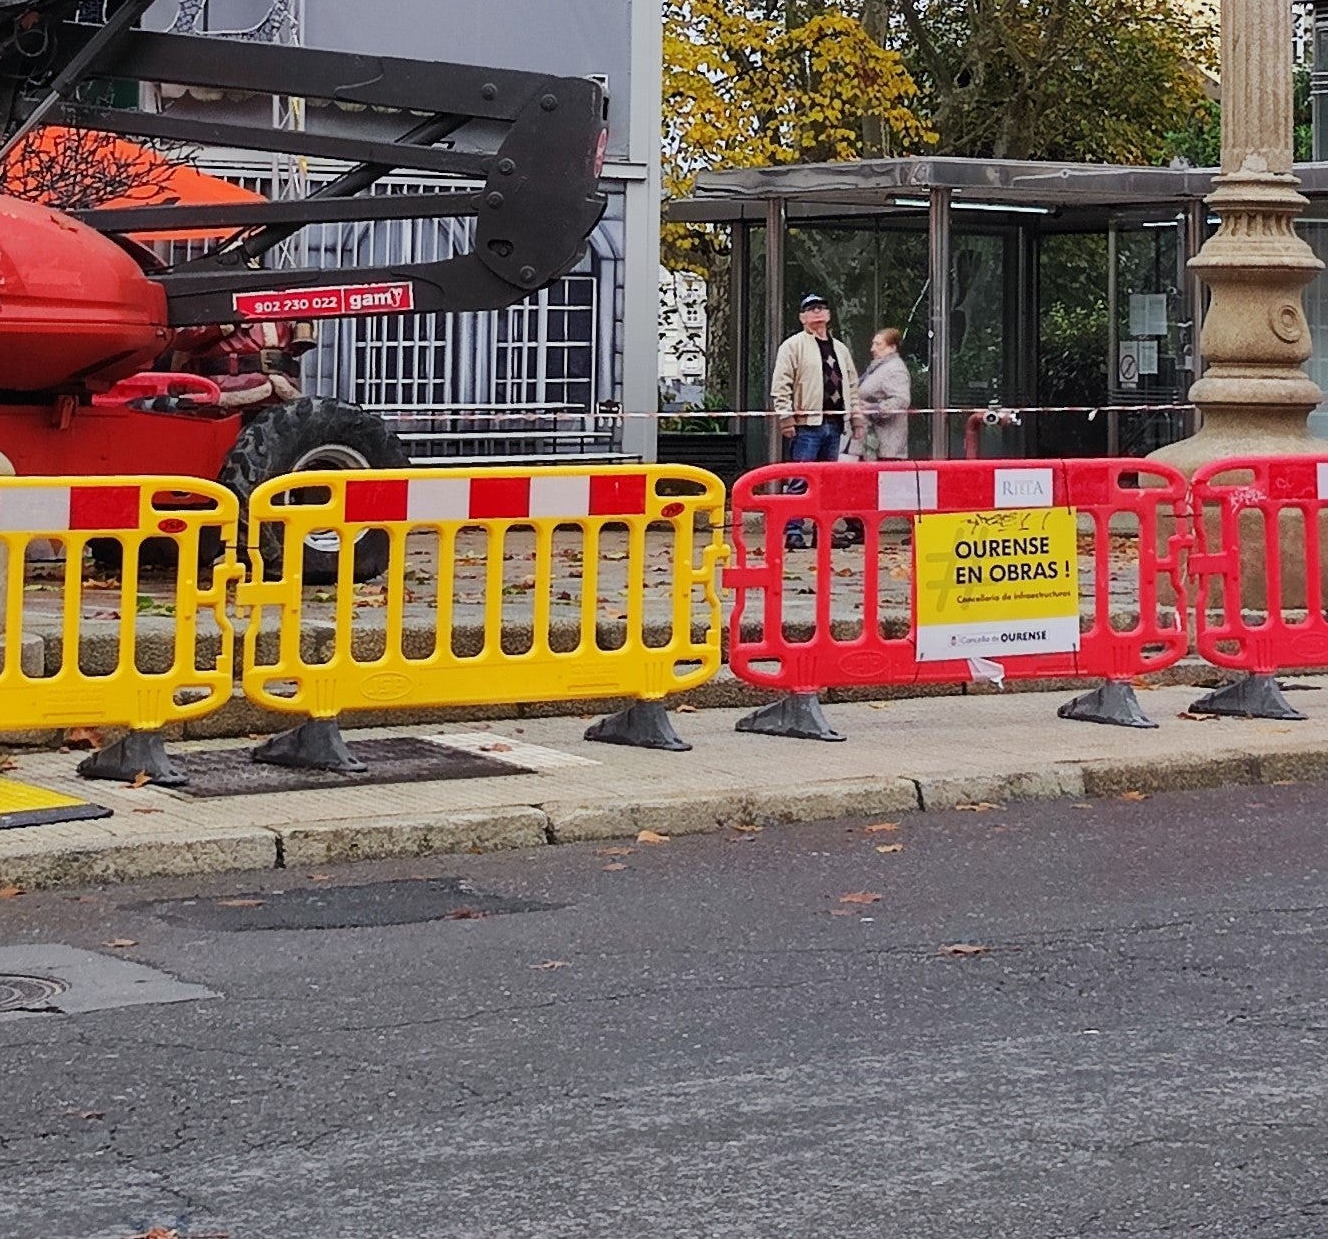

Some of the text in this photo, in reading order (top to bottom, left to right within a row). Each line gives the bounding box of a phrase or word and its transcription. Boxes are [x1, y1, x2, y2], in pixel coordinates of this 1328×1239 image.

[254, 301, 281, 313] 902
[312, 296, 338, 309] 022
[955, 536, 1050, 560] OURENSE
[956, 565, 983, 585] EN
[989, 560, 1059, 583] OBRAS
[1001, 592, 1012, 601] de
[1001, 630, 1047, 643] OURENSE
